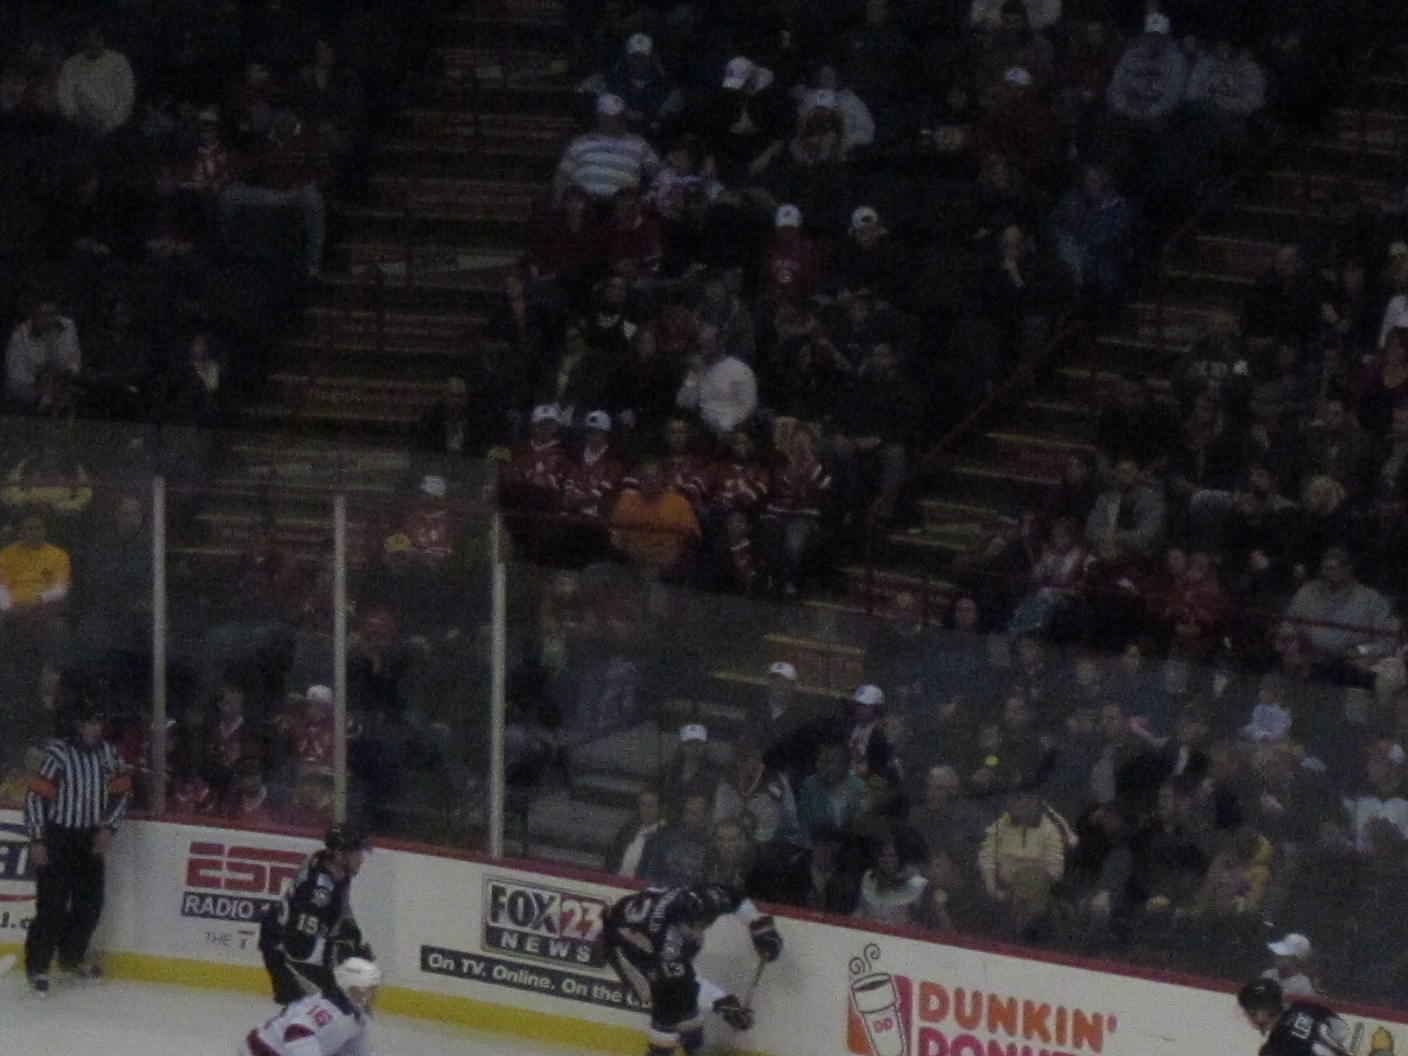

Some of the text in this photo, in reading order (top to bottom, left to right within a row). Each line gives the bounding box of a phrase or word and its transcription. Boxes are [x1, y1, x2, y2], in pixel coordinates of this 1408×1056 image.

[186, 842, 308, 895] ESP
[184, 895, 254, 919] RADIO
[500, 932, 592, 963] NEWS
[428, 953, 456, 970] On
[493, 965, 556, 990] Online.
[561, 978, 588, 996] On
[592, 984, 622, 1003] the
[918, 981, 1118, 1053] DUNKIN'
